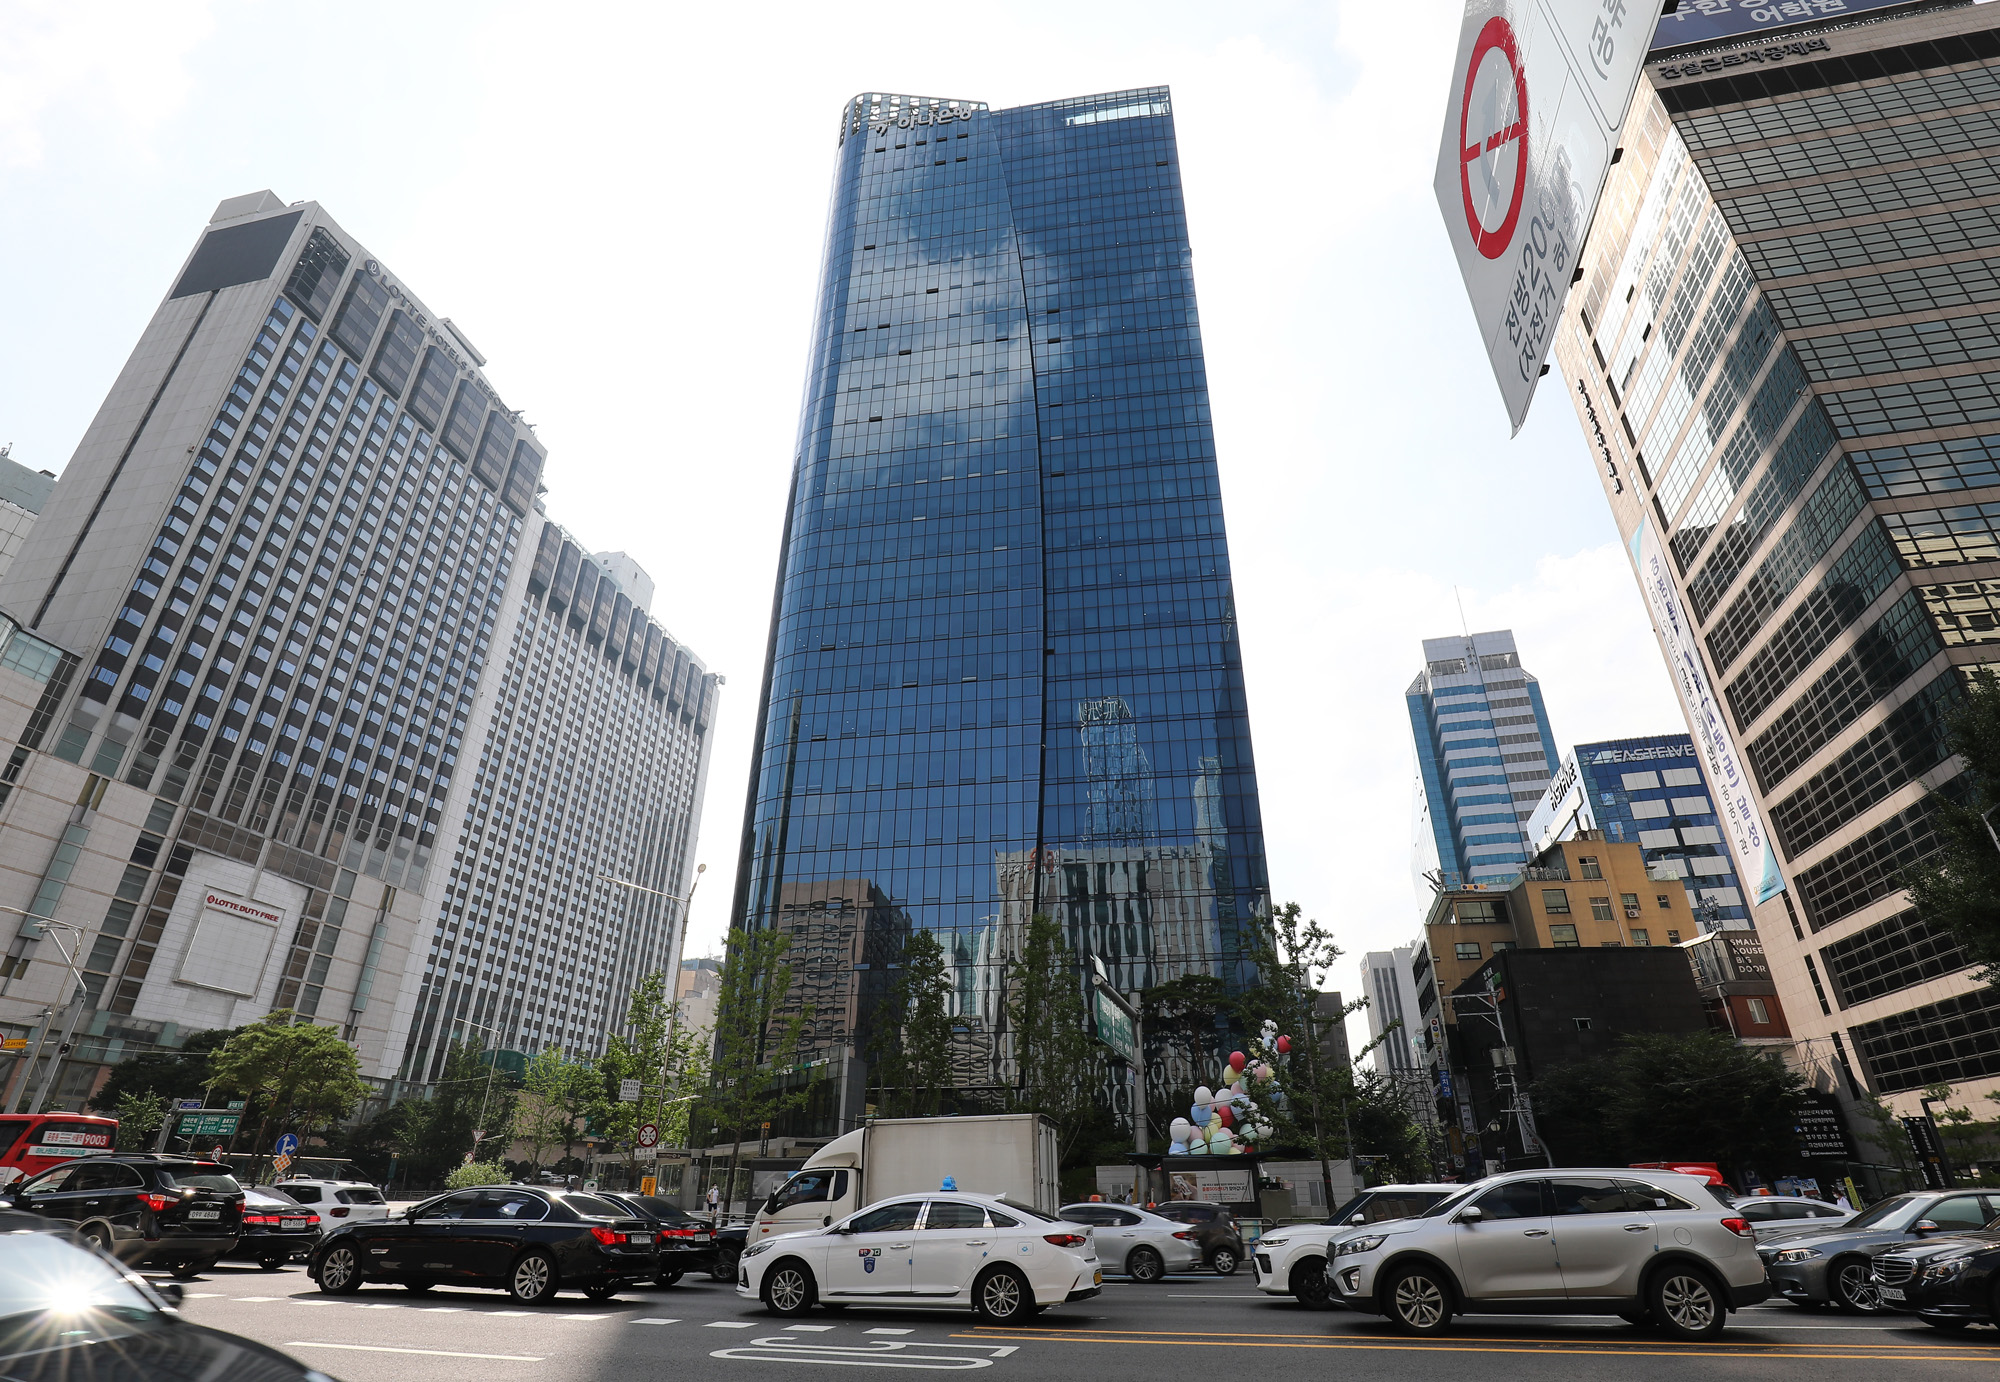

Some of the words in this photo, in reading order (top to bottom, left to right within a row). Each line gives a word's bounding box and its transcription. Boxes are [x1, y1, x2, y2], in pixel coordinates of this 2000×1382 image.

[1658, 37, 1831, 79] 건설근로자공제회
[1519, 271, 1556, 383] (자전거
[381, 275, 428, 328] LOTTE
[427, 325, 467, 370] HOTELS
[467, 369, 475, 380] &
[476, 377, 518, 424] RESORTS
[1612, 744, 1696, 764] FASTFIVE
[1720, 784, 1750, 856] 공공기관
[1736, 795, 1760, 848] 달성
[215, 898, 239, 911] LOTTE
[239, 905, 261, 917] DUTY
[260, 911, 279, 922] FREE
[1729, 938, 1761, 946] SMALL
[1732, 947, 1764, 955] HOUSE
[1736, 956, 1752, 964] BIG
[1738, 965, 1767, 973] DOOR
[85, 1134, 107, 1146] 9003
[212, 1149, 220, 1160] 50
